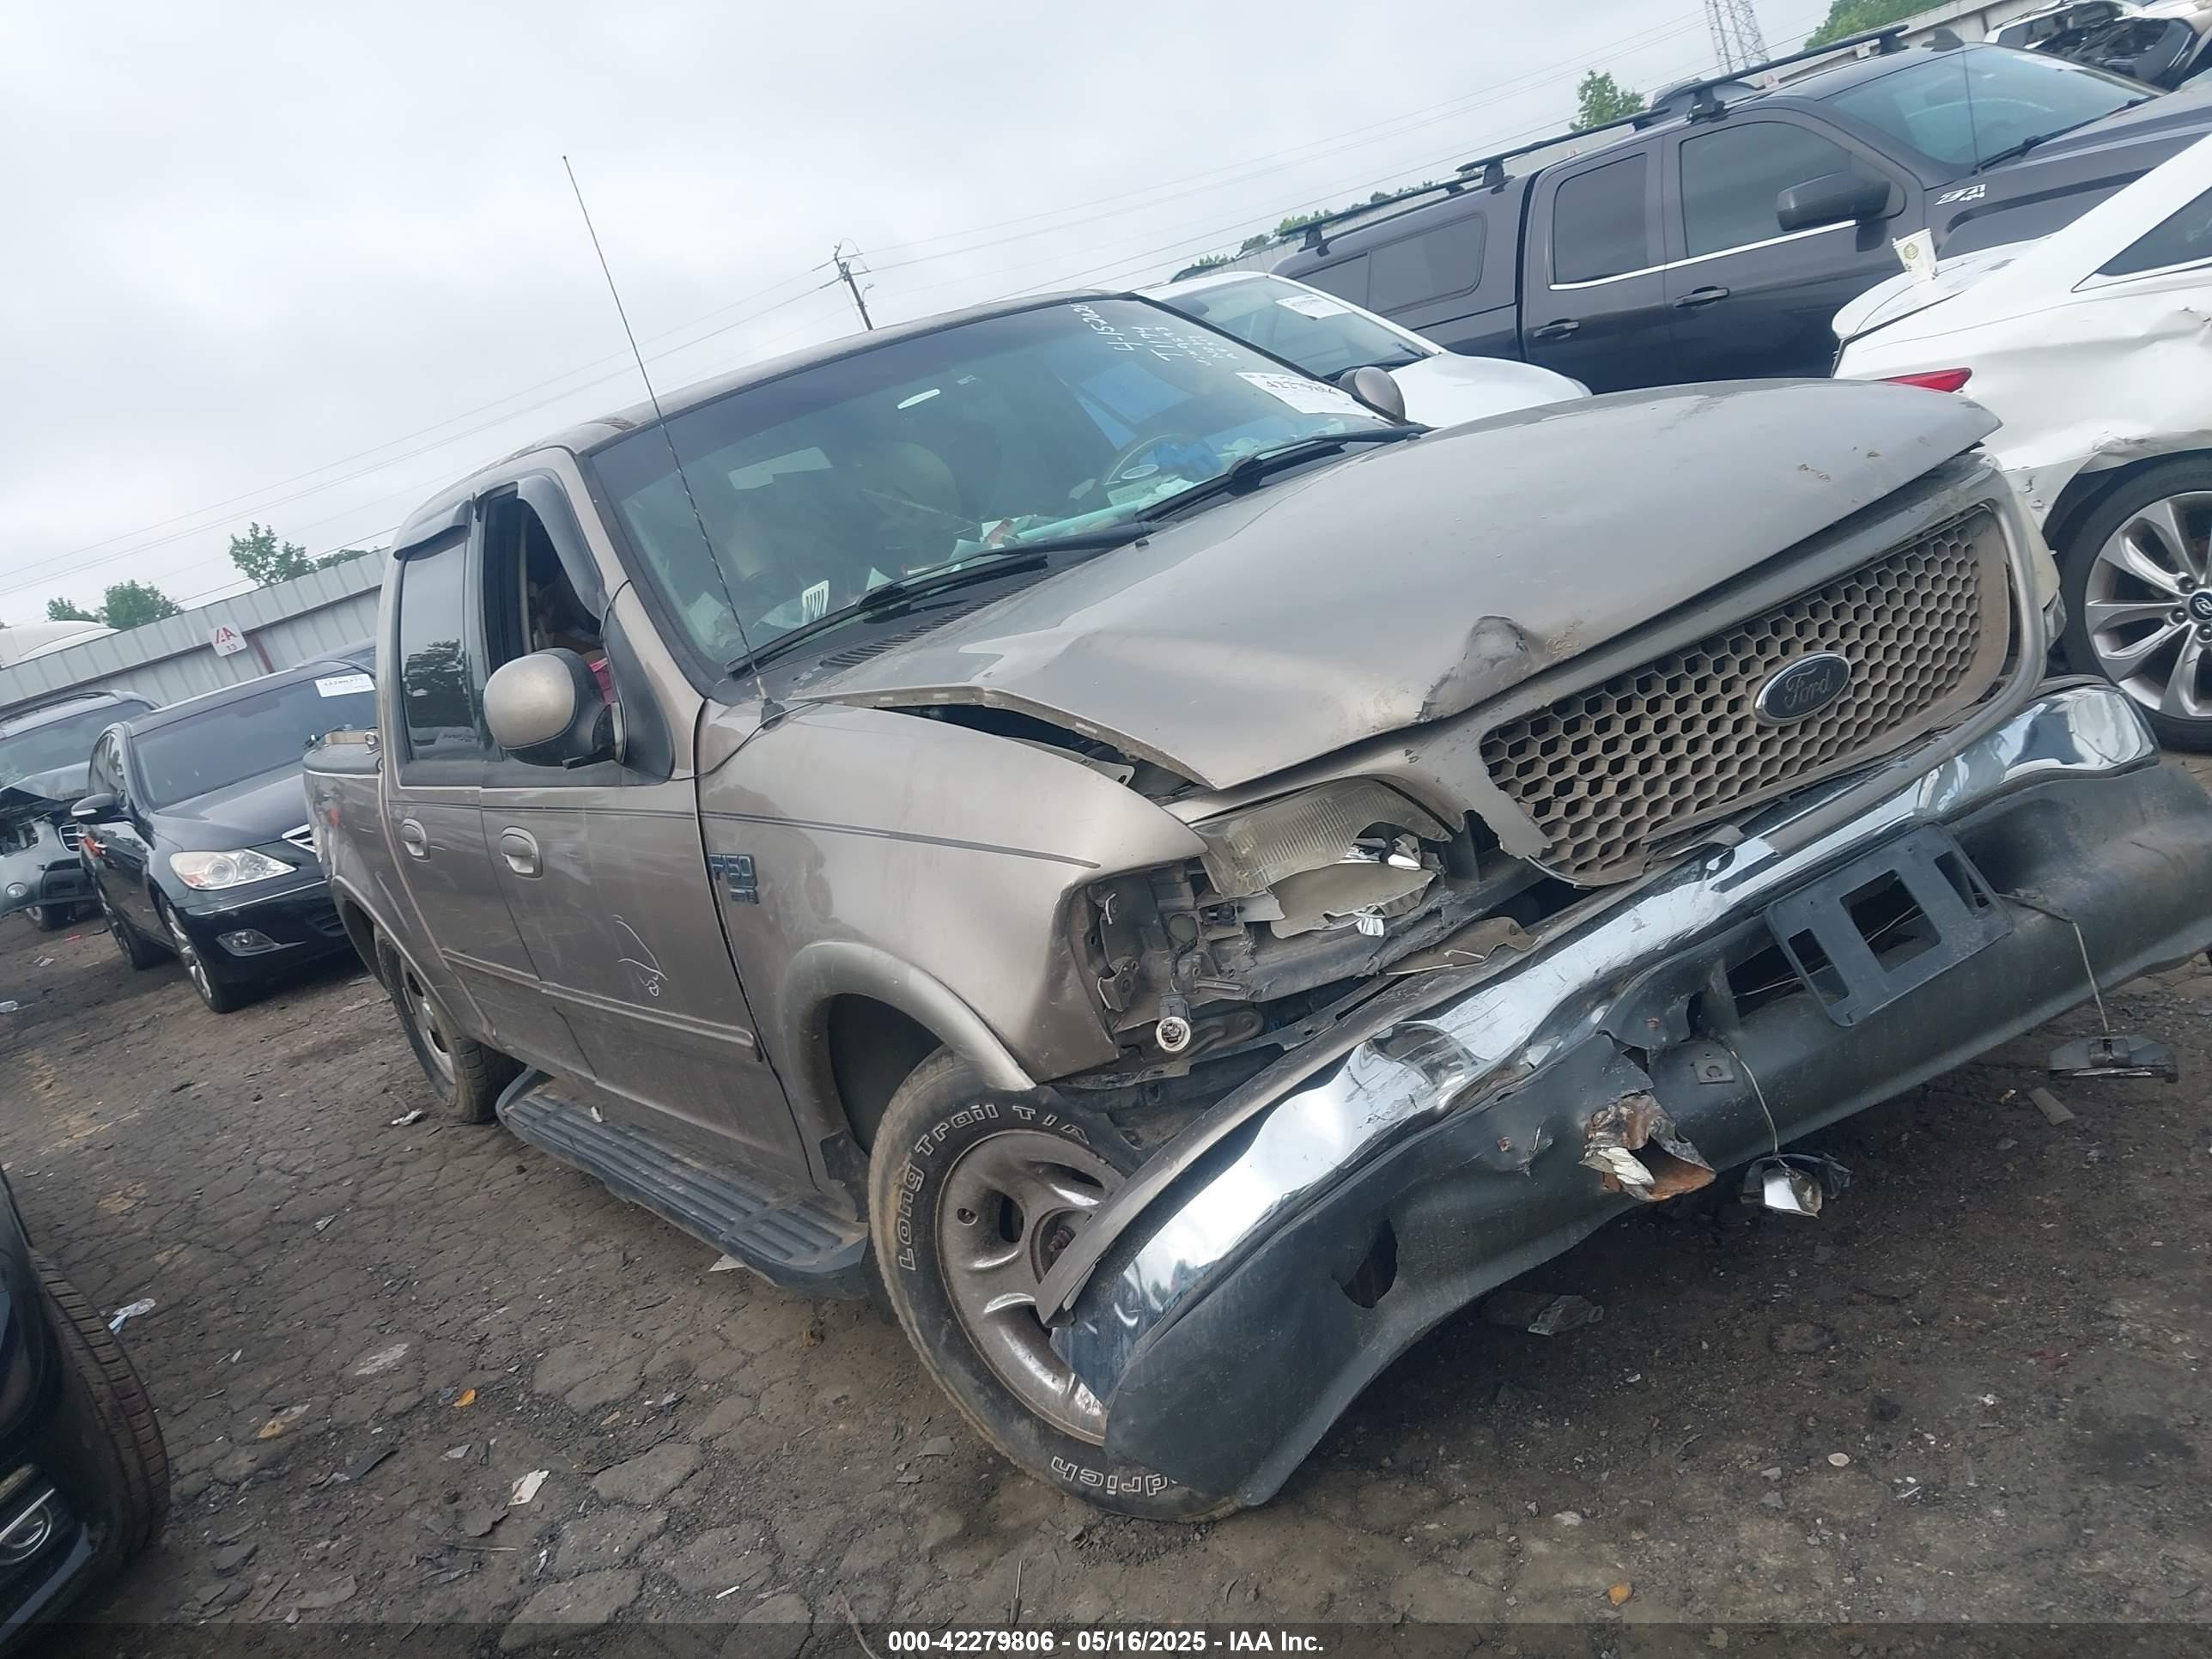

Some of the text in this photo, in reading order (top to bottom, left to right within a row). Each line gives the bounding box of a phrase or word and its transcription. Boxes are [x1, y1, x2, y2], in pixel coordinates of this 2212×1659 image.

[1784, 667, 1831, 708] Ford
[897, 1164, 926, 1272] Long
[915, 1104, 1000, 1157] Trail
